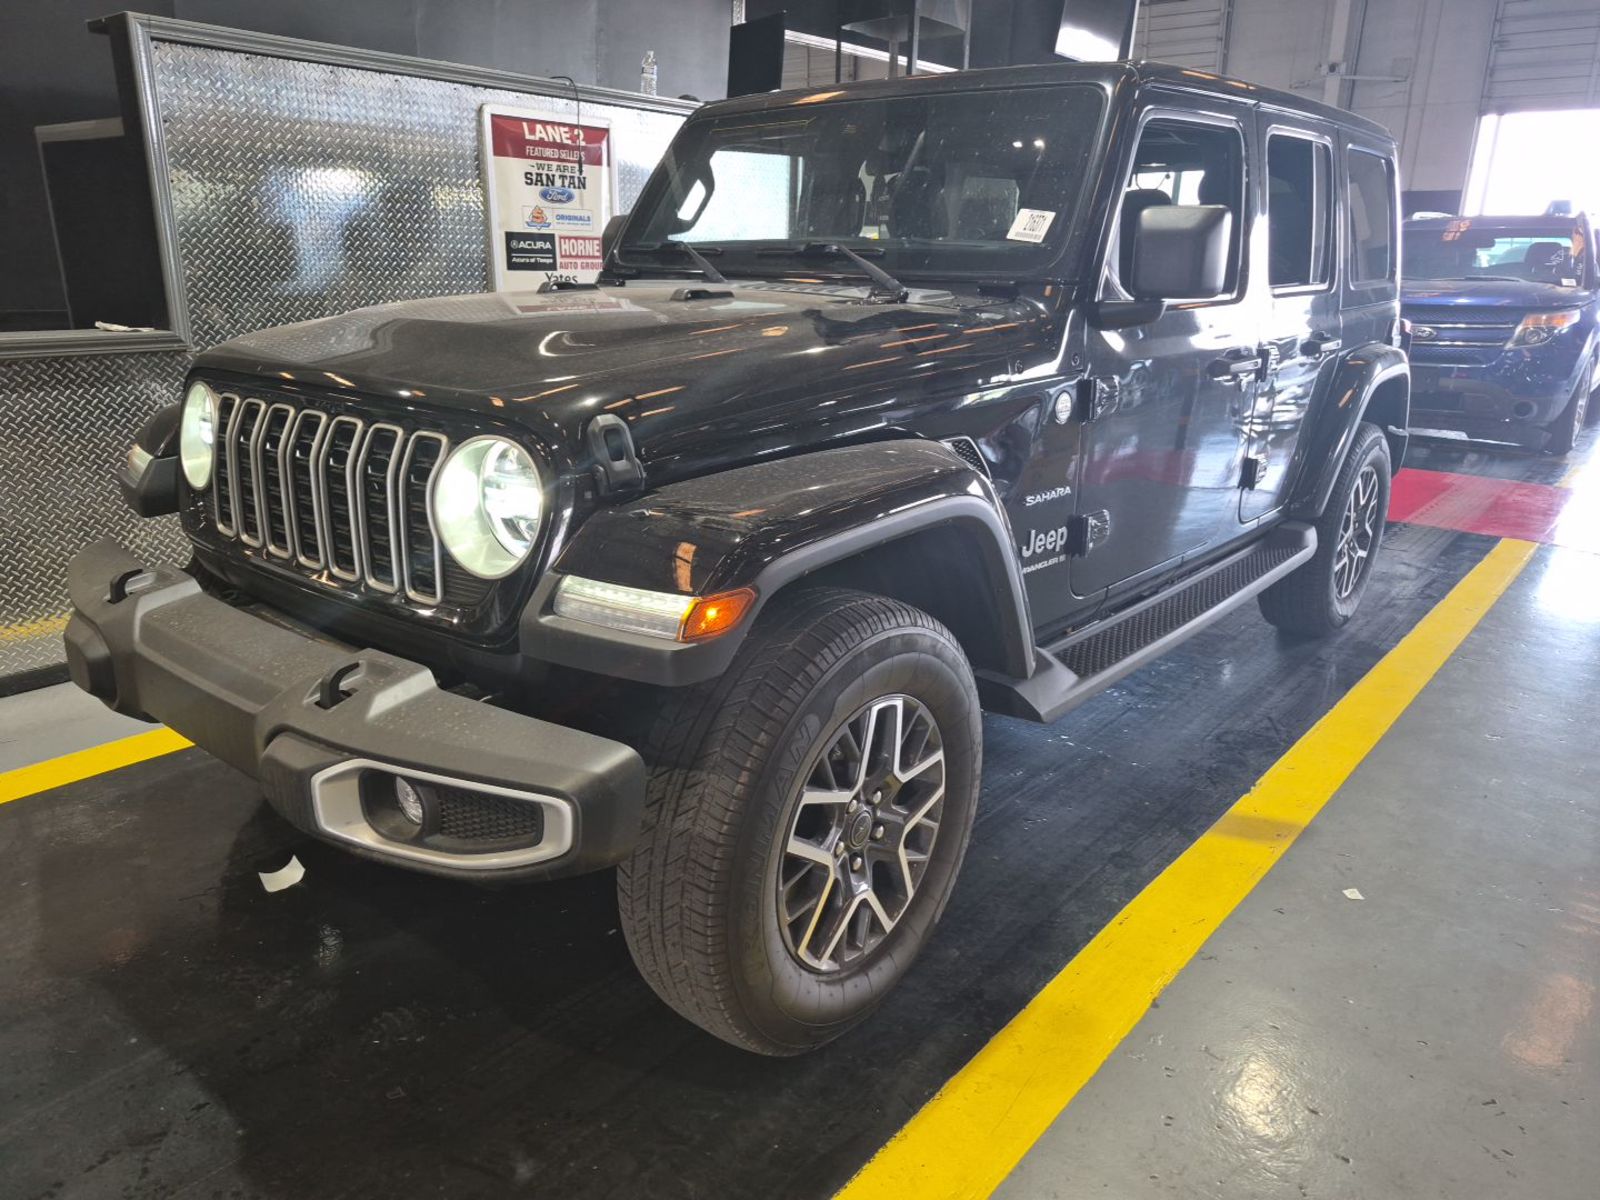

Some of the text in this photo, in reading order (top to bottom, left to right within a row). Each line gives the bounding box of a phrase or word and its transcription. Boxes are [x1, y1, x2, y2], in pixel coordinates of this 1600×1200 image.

[522, 121, 586, 146] LANE 2
[526, 146, 585, 161] FEATURED SELLES
[536, 162, 577, 174] WE ARE
[524, 172, 587, 190] SAN TAN
[546, 189, 569, 200] Ford
[555, 214, 591, 222] ORIGINALS
[519, 241, 552, 249] ACURA
[560, 238, 601, 257] HORNE
[559, 261, 579, 270] AUTO
[1025, 485, 1072, 506] SAHARA
[1021, 525, 1068, 558] Jeep
[1021, 557, 1059, 575] RANGLER
